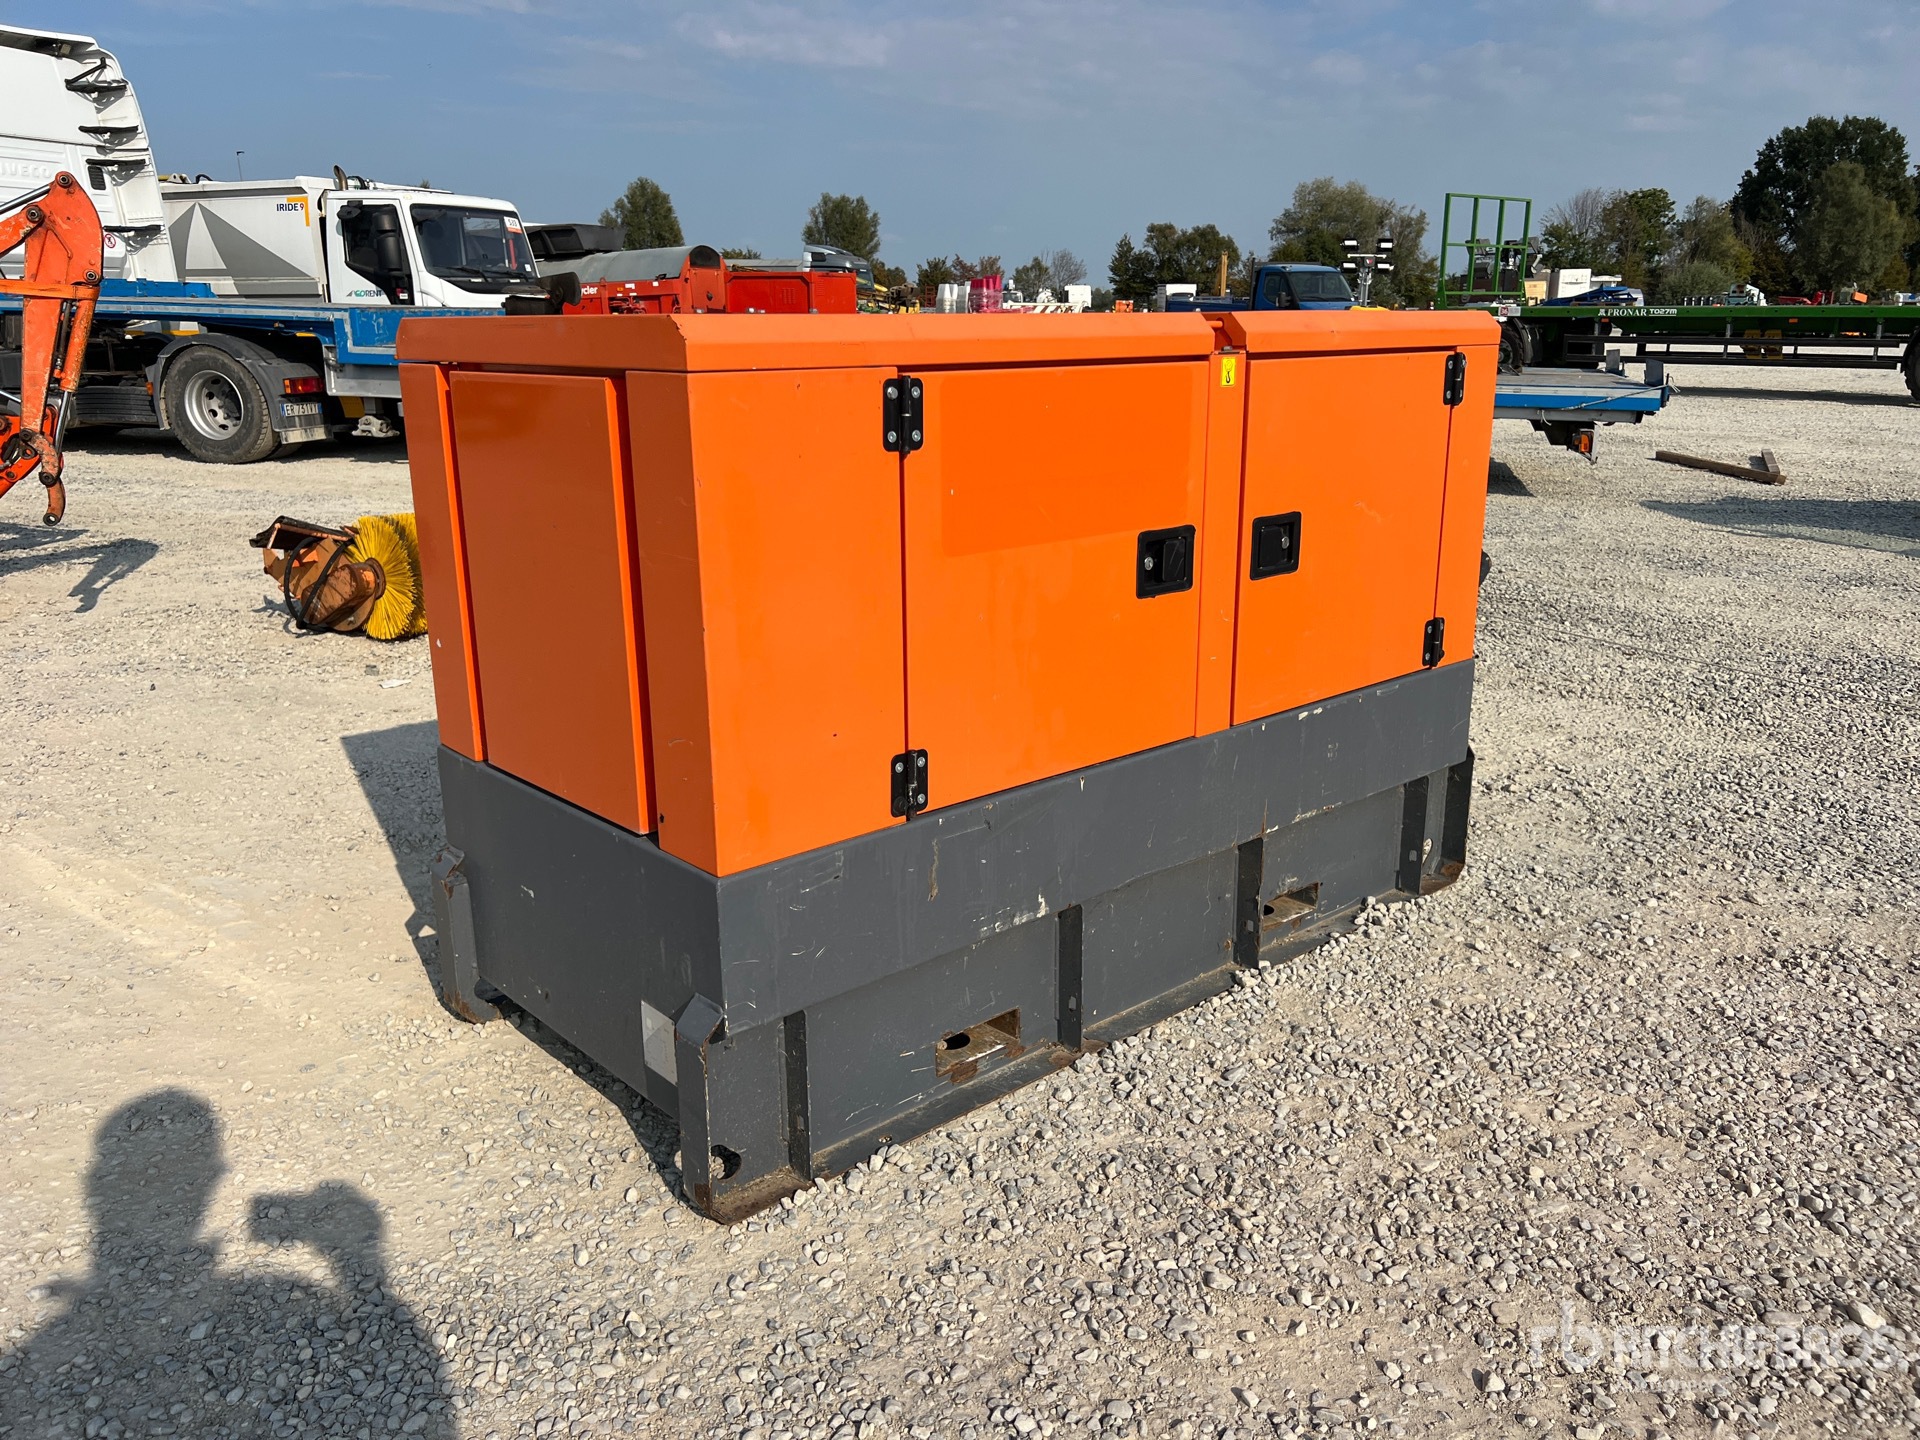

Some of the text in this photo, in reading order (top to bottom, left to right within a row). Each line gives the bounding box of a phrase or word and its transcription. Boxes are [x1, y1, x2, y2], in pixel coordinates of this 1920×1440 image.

[276, 202, 305, 212] IRIDE 9
[1607, 308, 1647, 317] PRONAR
